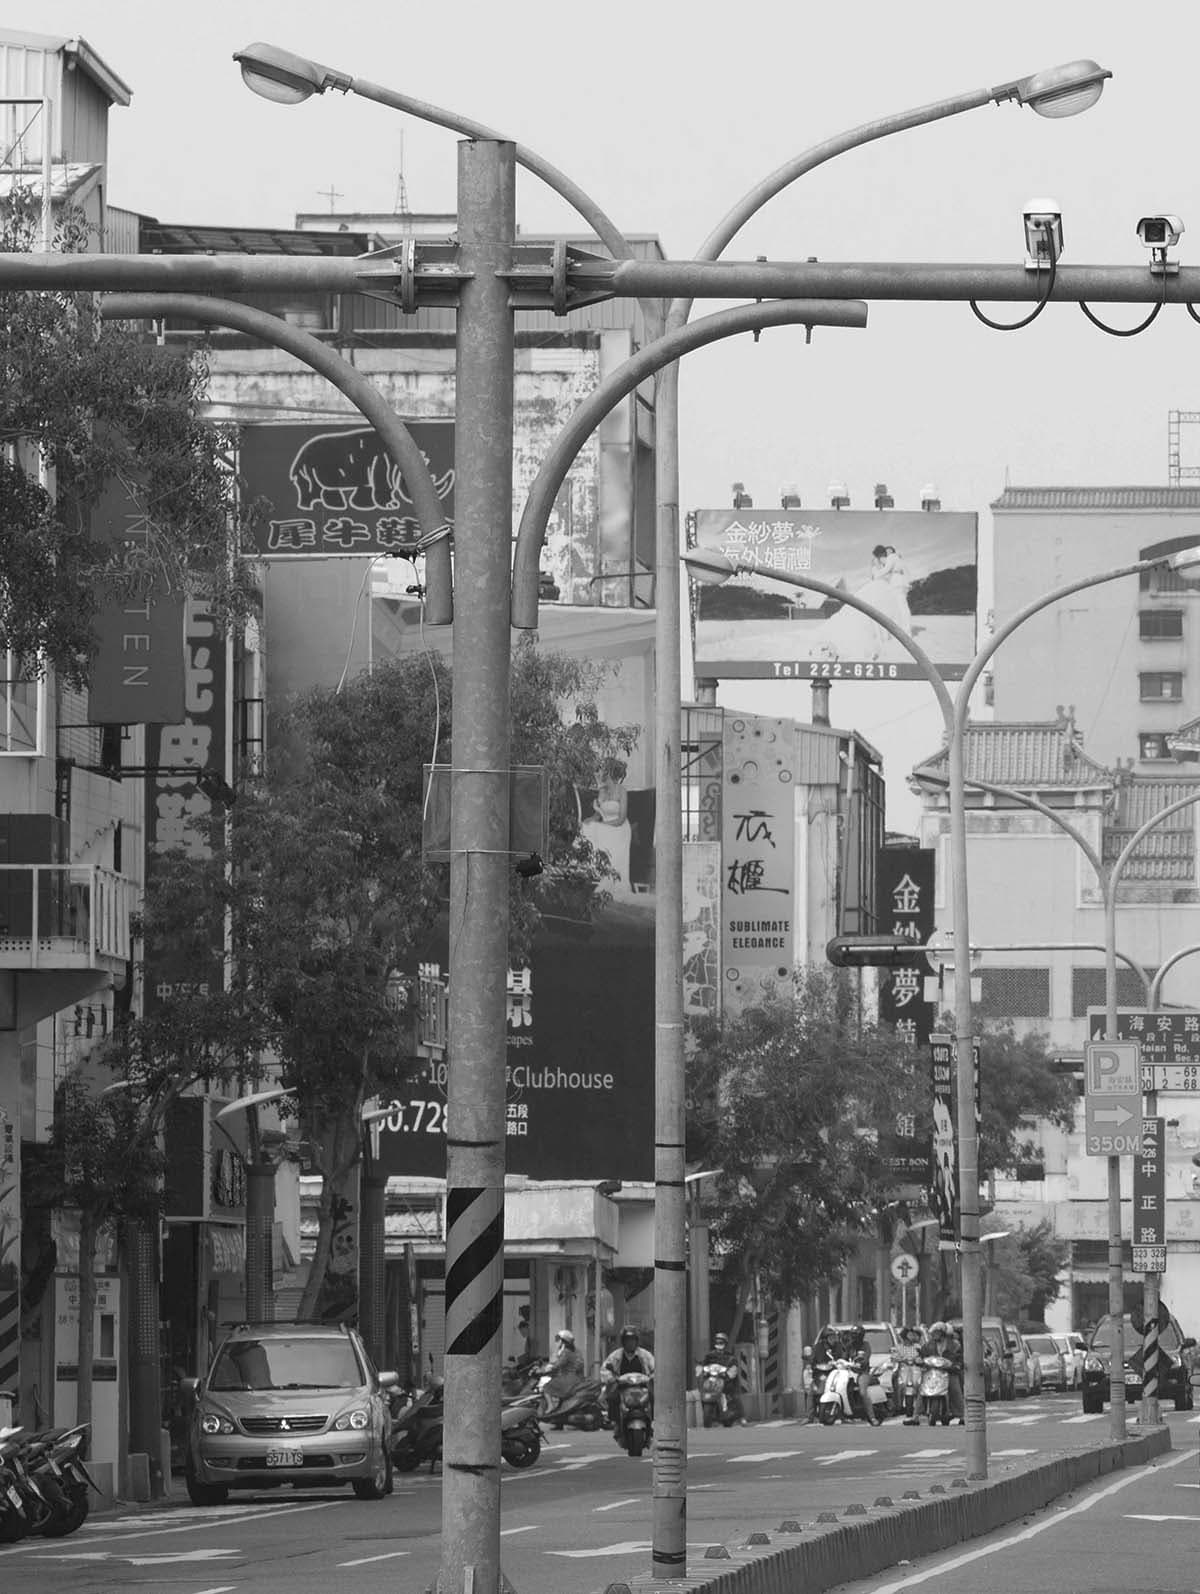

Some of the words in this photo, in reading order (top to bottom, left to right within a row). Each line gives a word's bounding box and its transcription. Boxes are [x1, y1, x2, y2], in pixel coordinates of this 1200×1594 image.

[725, 521, 794, 544] 金紗夢
[774, 663, 799, 676] Tel
[810, 663, 897, 677] 222-6216
[729, 920, 790, 932] SUBLIMATE
[732, 937, 785, 949] ELEGANCE
[1129, 1016, 1199, 1031] 海安路
[1173, 1043, 1190, 1053] Rd.
[512, 1066, 614, 1089] Clubhouse
[1142, 1120, 1158, 1135] 西
[1090, 1136, 1140, 1152] 350M
[1141, 1161, 1157, 1242] 中正路
